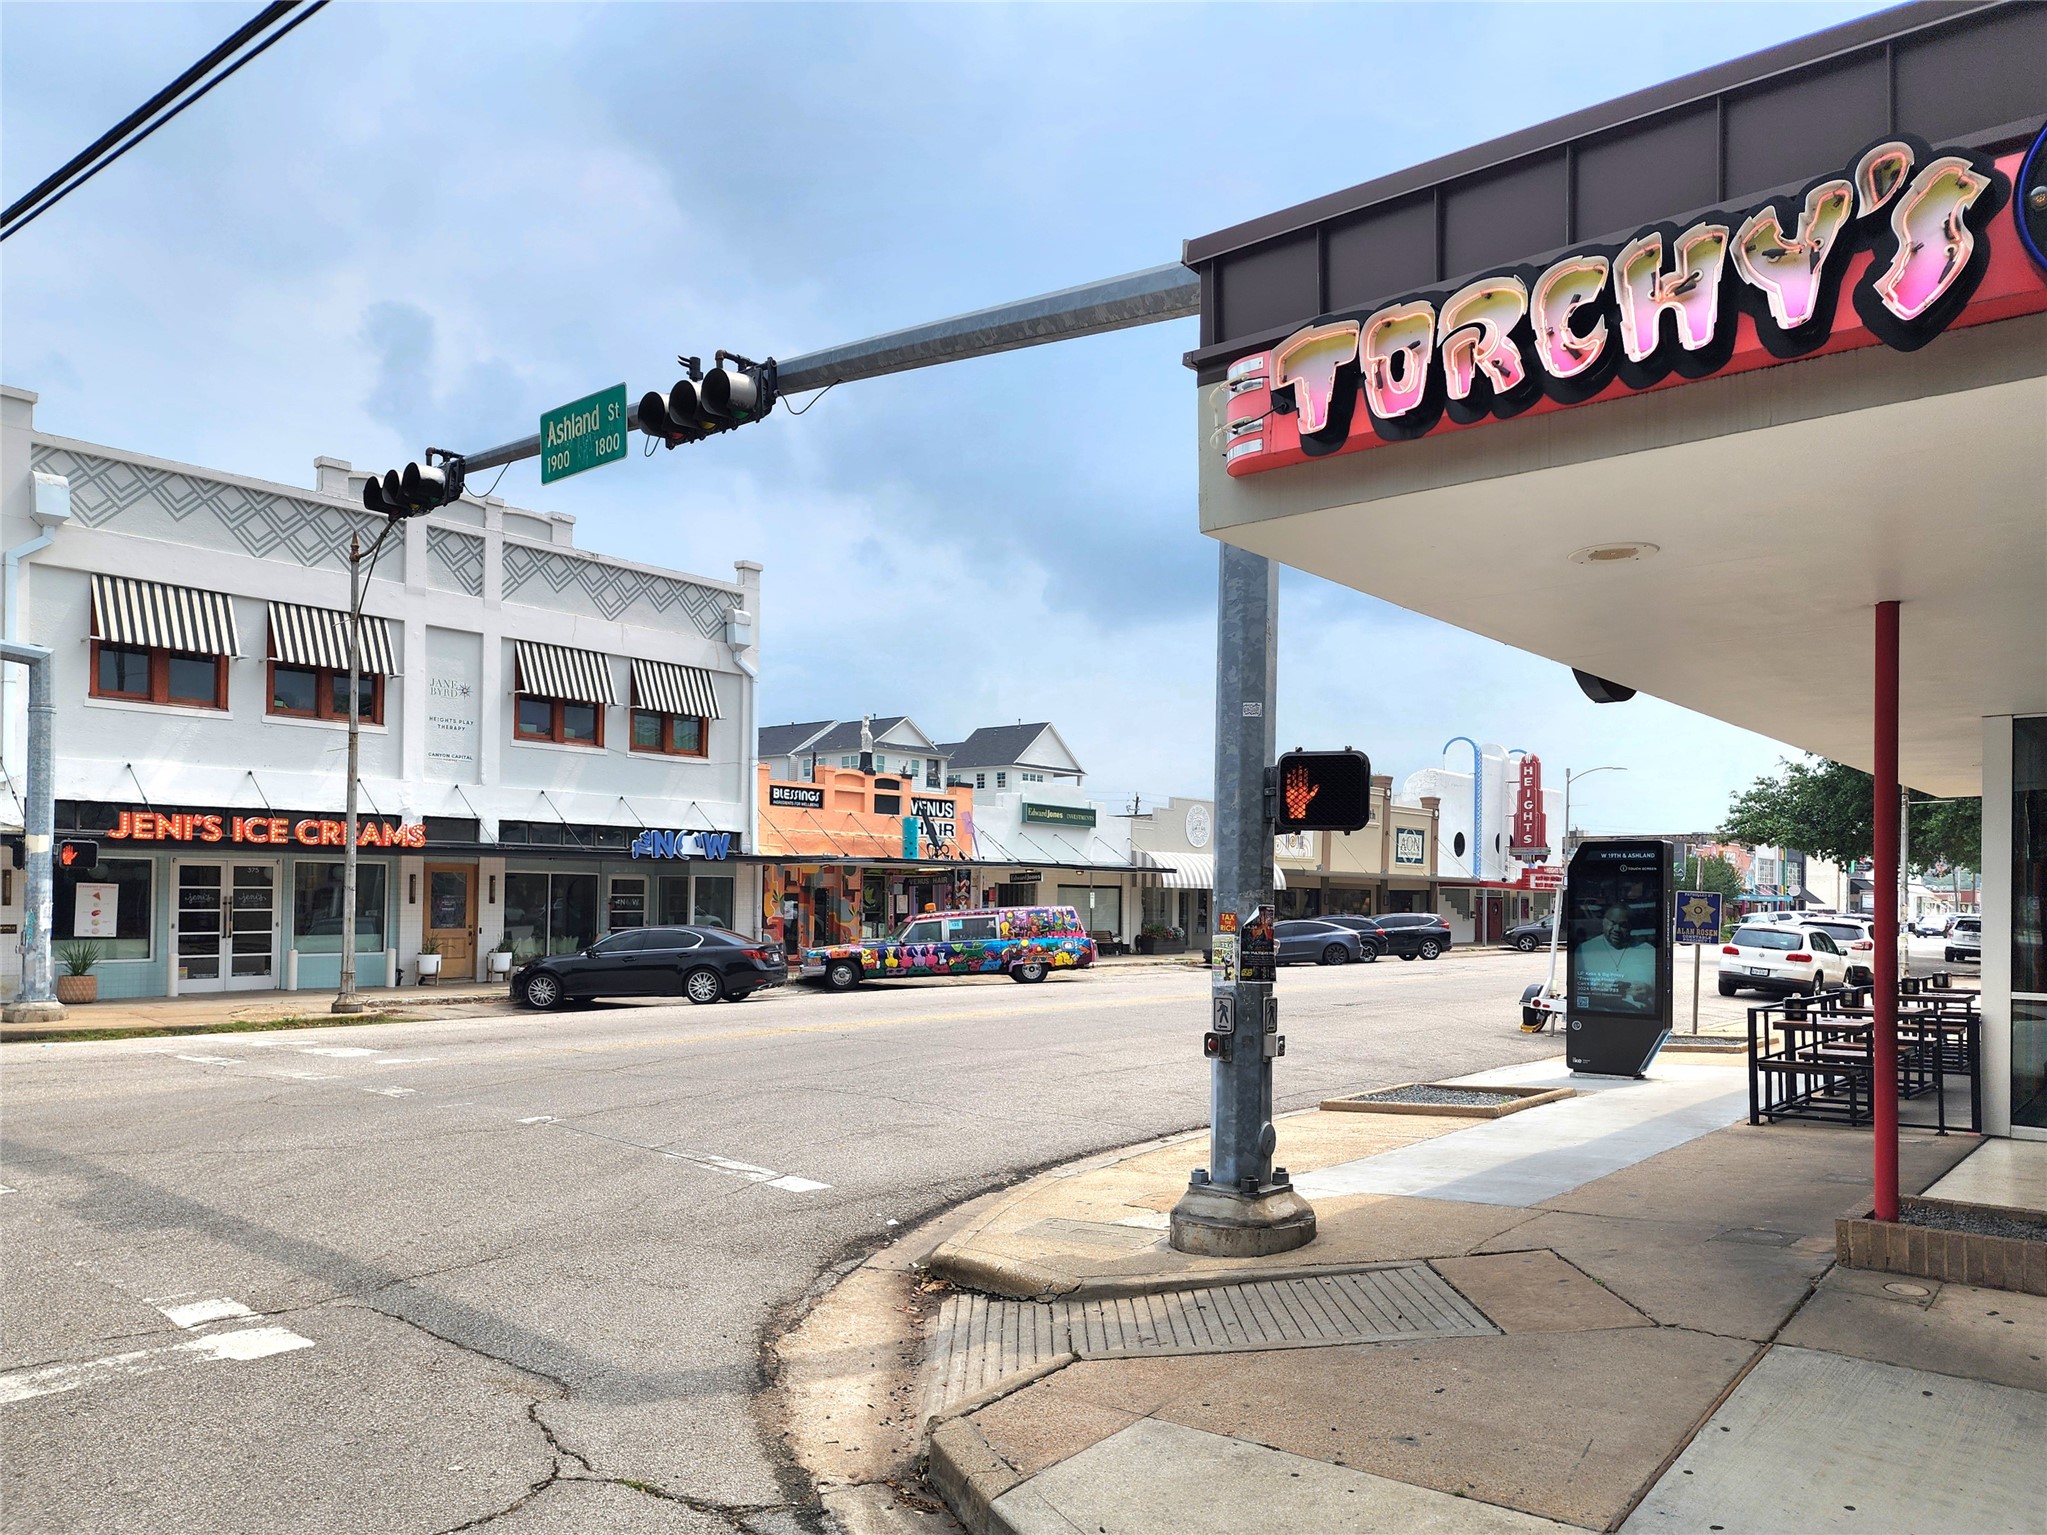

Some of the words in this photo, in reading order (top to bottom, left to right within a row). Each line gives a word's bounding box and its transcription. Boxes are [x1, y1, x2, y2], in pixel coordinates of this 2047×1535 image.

[1270, 140, 1989, 435] TORCHY'S
[547, 403, 600, 448] Ashland
[608, 401, 620, 421] St
[547, 450, 570, 474] 1900
[595, 432, 620, 457] 1800
[430, 678, 458, 689] JANE
[430, 687, 458, 697] BYRD
[429, 716, 457, 724] HEIGHTS
[437, 723, 466, 731] THERAPY
[773, 788, 820, 802] BLESSINGS
[1523, 766, 1534, 844] HEIGHTS
[108, 811, 223, 842] JENI'S
[232, 816, 289, 844] ICE
[1221, 913, 1235, 921] TAX
[1220, 924, 1236, 932] RICH
[1677, 927, 1694, 935] ALAN
[1696, 929, 1718, 937] ROSEN
